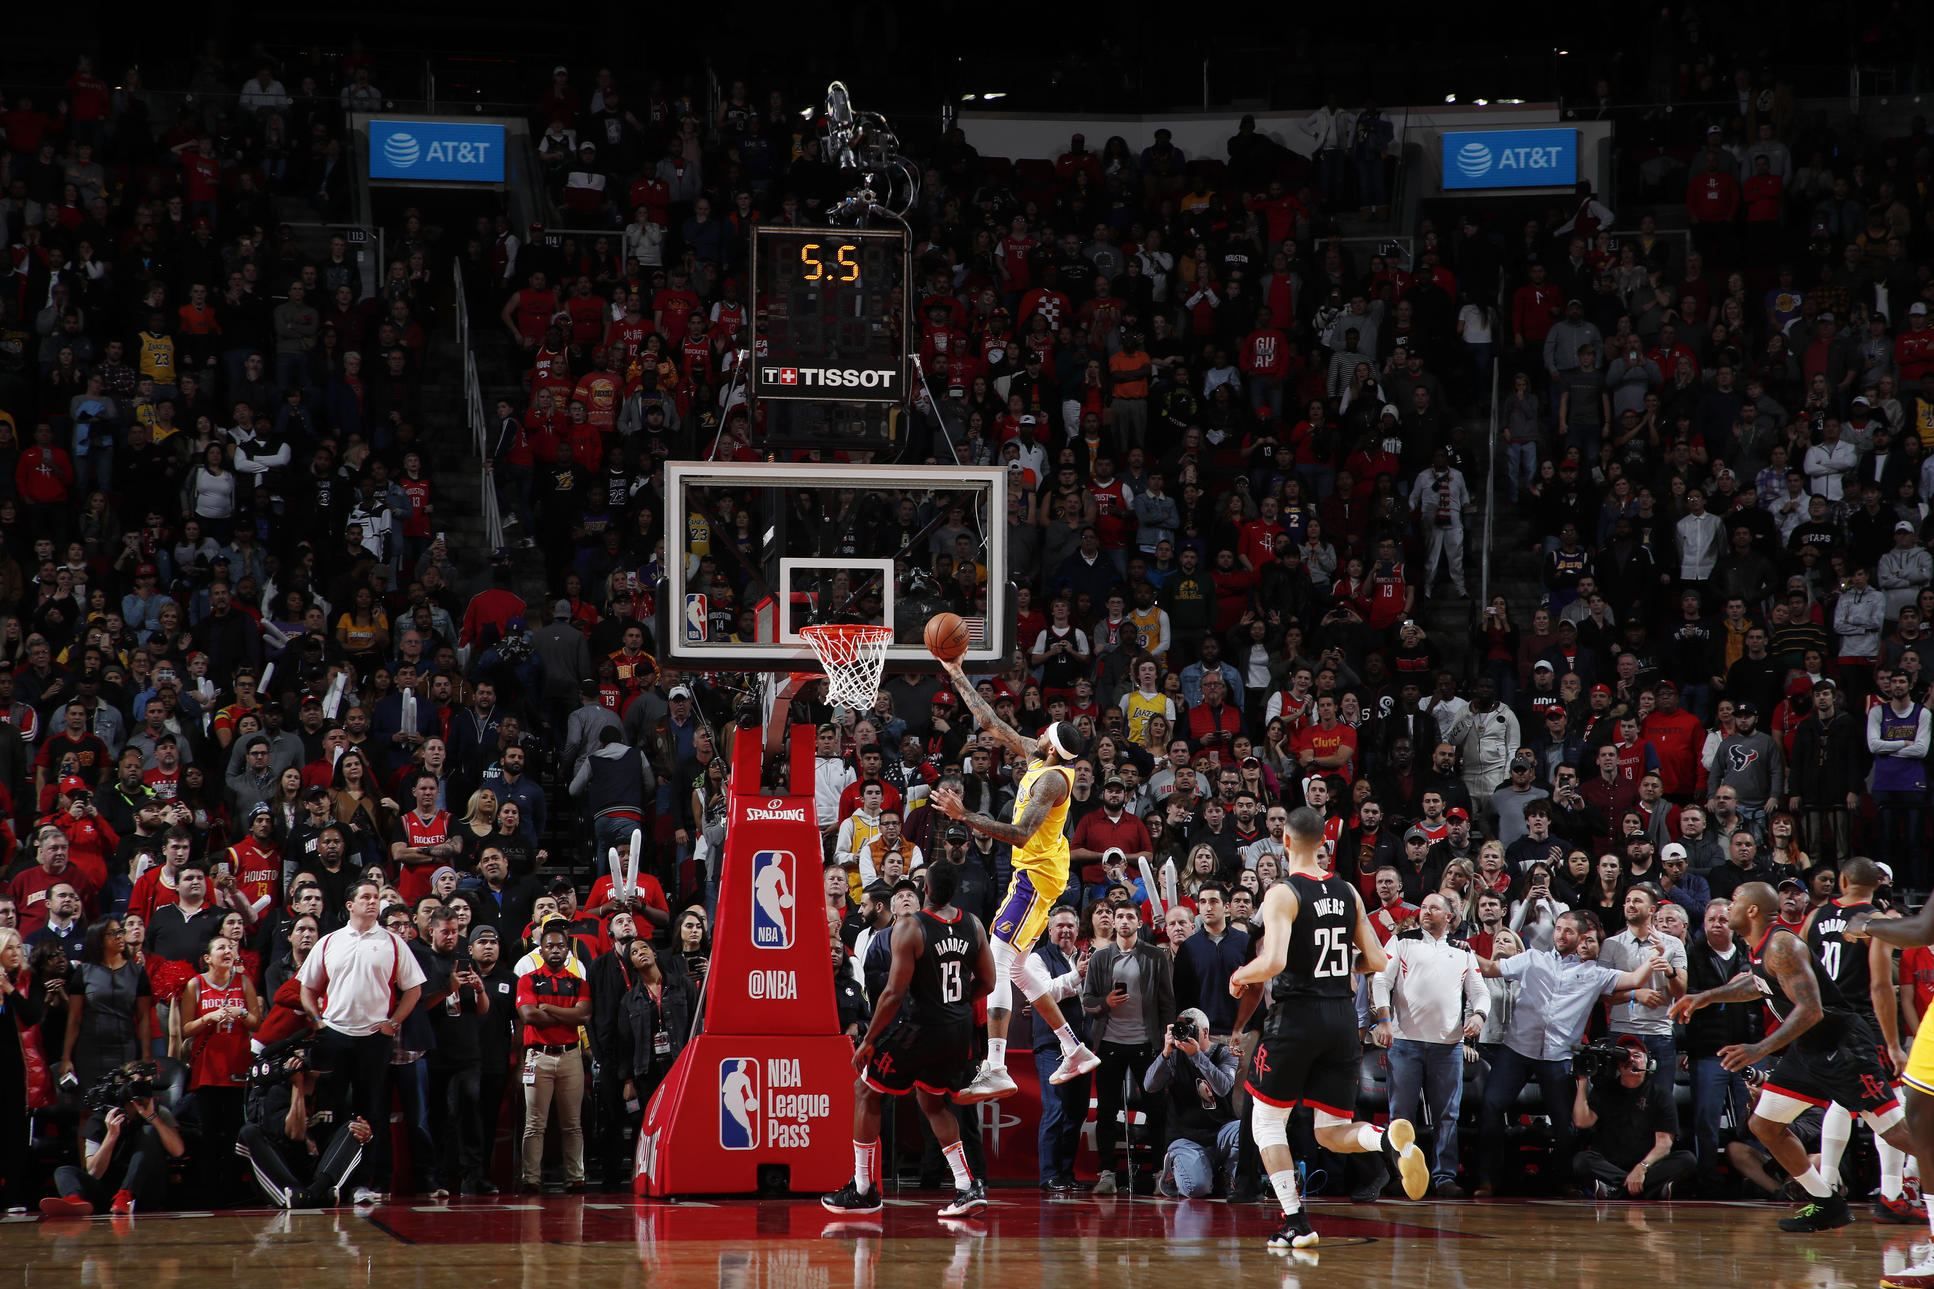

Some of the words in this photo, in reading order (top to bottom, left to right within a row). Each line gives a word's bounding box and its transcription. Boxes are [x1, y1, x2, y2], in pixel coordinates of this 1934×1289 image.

[426, 141, 490, 164] AT&T
[1498, 147, 1563, 170] AT&T
[351, 231, 364, 241] 113
[545, 236, 558, 245] 114
[1224, 254, 1249, 264] HOUSTON
[623, 329, 643, 341] 火箭
[629, 344, 638, 356] 12
[1255, 337, 1276, 350] GU
[684, 347, 708, 356] ROCKETS
[154, 352, 169, 367] 23
[1255, 355, 1275, 368] AP
[799, 368, 896, 388] TISSOT
[1263, 446, 1272, 457] 13
[412, 496, 420, 508] 13
[1289, 514, 1299, 528] 2
[690, 529, 708, 543] 23
[1376, 576, 1401, 584] ROCKETS
[1383, 584, 1393, 598] 13
[708, 611, 731, 621] HOUSTON
[716, 620, 724, 631] 14
[688, 631, 700, 640] NBA
[605, 695, 615, 707] 13
[1625, 766, 1633, 780] 13
[746, 807, 806, 823] SPALDING
[413, 834, 446, 845] ROCKETS
[257, 882, 268, 897] 13
[1313, 899, 1346, 918] RIVERS
[758, 926, 779, 942] NBA
[934, 936, 969, 957] HARDEN
[1313, 926, 1349, 979] 25
[1820, 940, 1843, 983] 10
[748, 969, 798, 1001] @NBA
[939, 959, 962, 1005] 13
[201, 997, 245, 1010] ROCKETS
[767, 1057, 802, 1088] NBA
[767, 1093, 830, 1123] League
[767, 1123, 810, 1149] Pass
